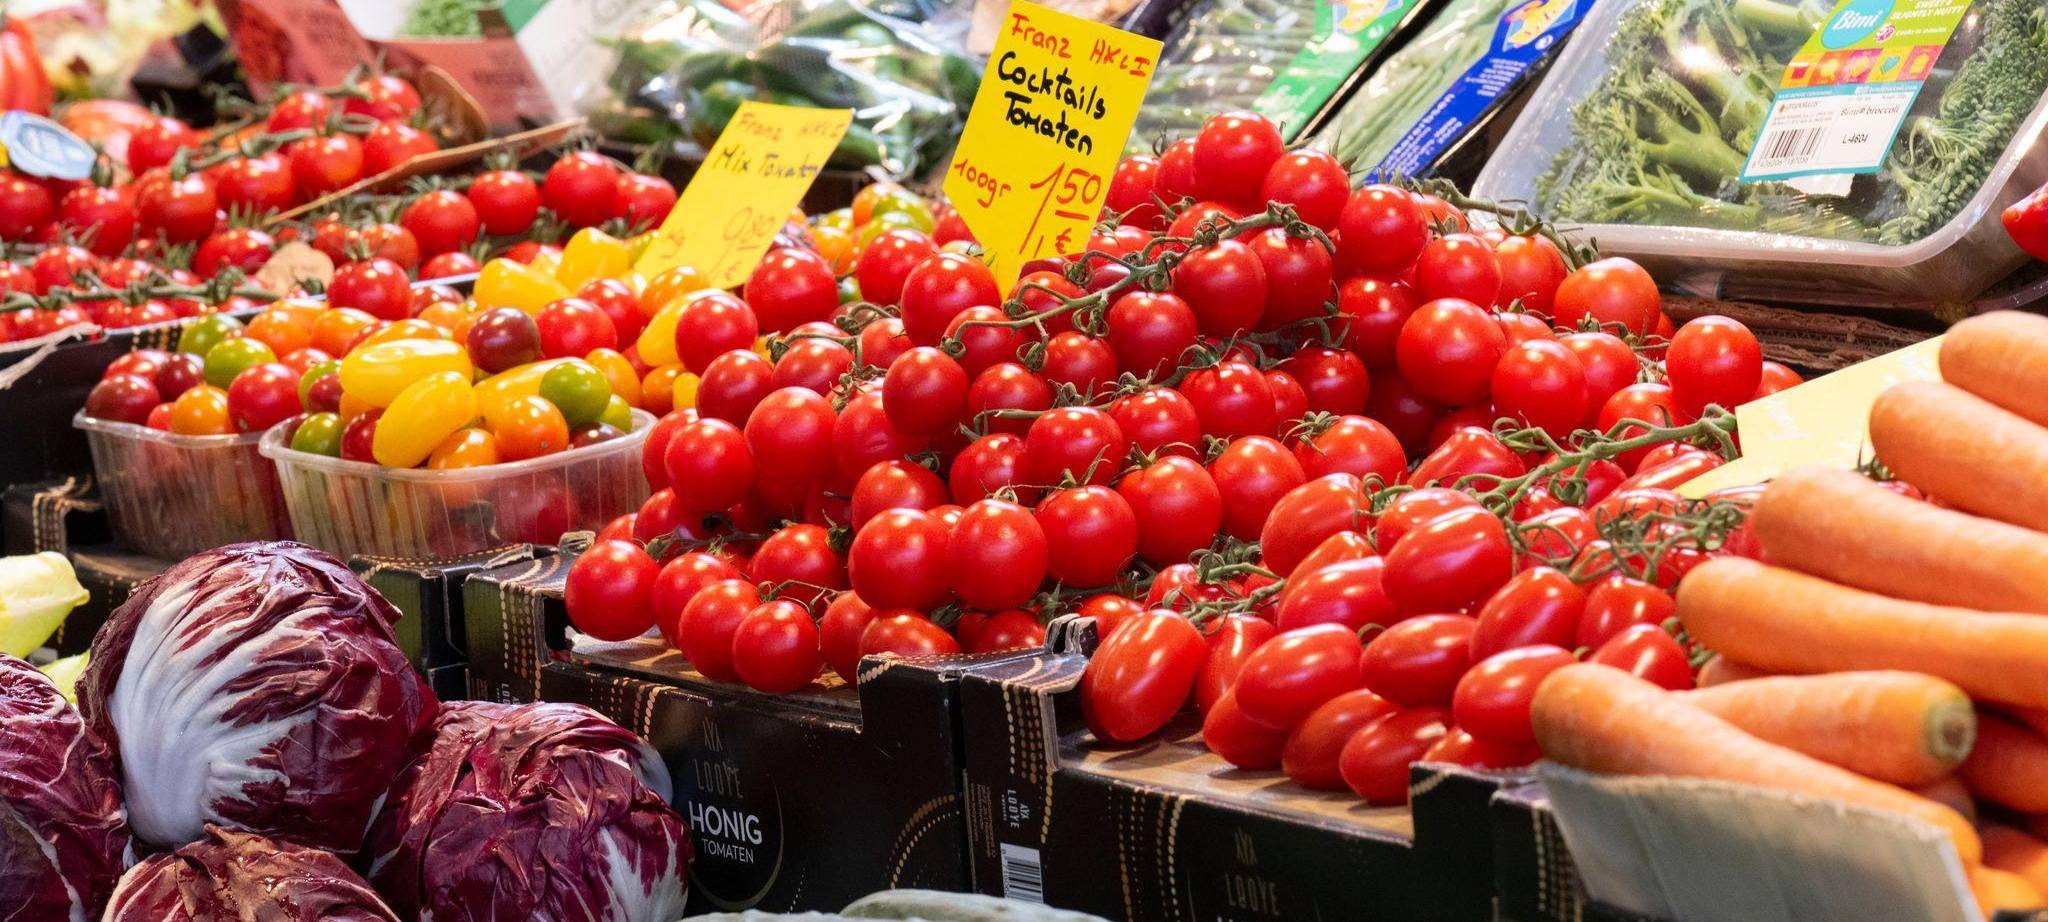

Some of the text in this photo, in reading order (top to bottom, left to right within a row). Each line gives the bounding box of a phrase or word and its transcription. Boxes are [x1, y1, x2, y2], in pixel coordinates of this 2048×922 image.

[1012, 13, 1072, 58] Franz
[1833, 10, 1883, 30] Bimi
[998, 51, 1106, 119] Cocktails
[1004, 91, 1093, 156] Tomaten
[712, 144, 751, 173] Mix
[954, 159, 1011, 208] 100gr
[688, 801, 763, 845] HONIG
[1007, 789, 1020, 829] LOOYE
[702, 838, 754, 863] TOMATEN
